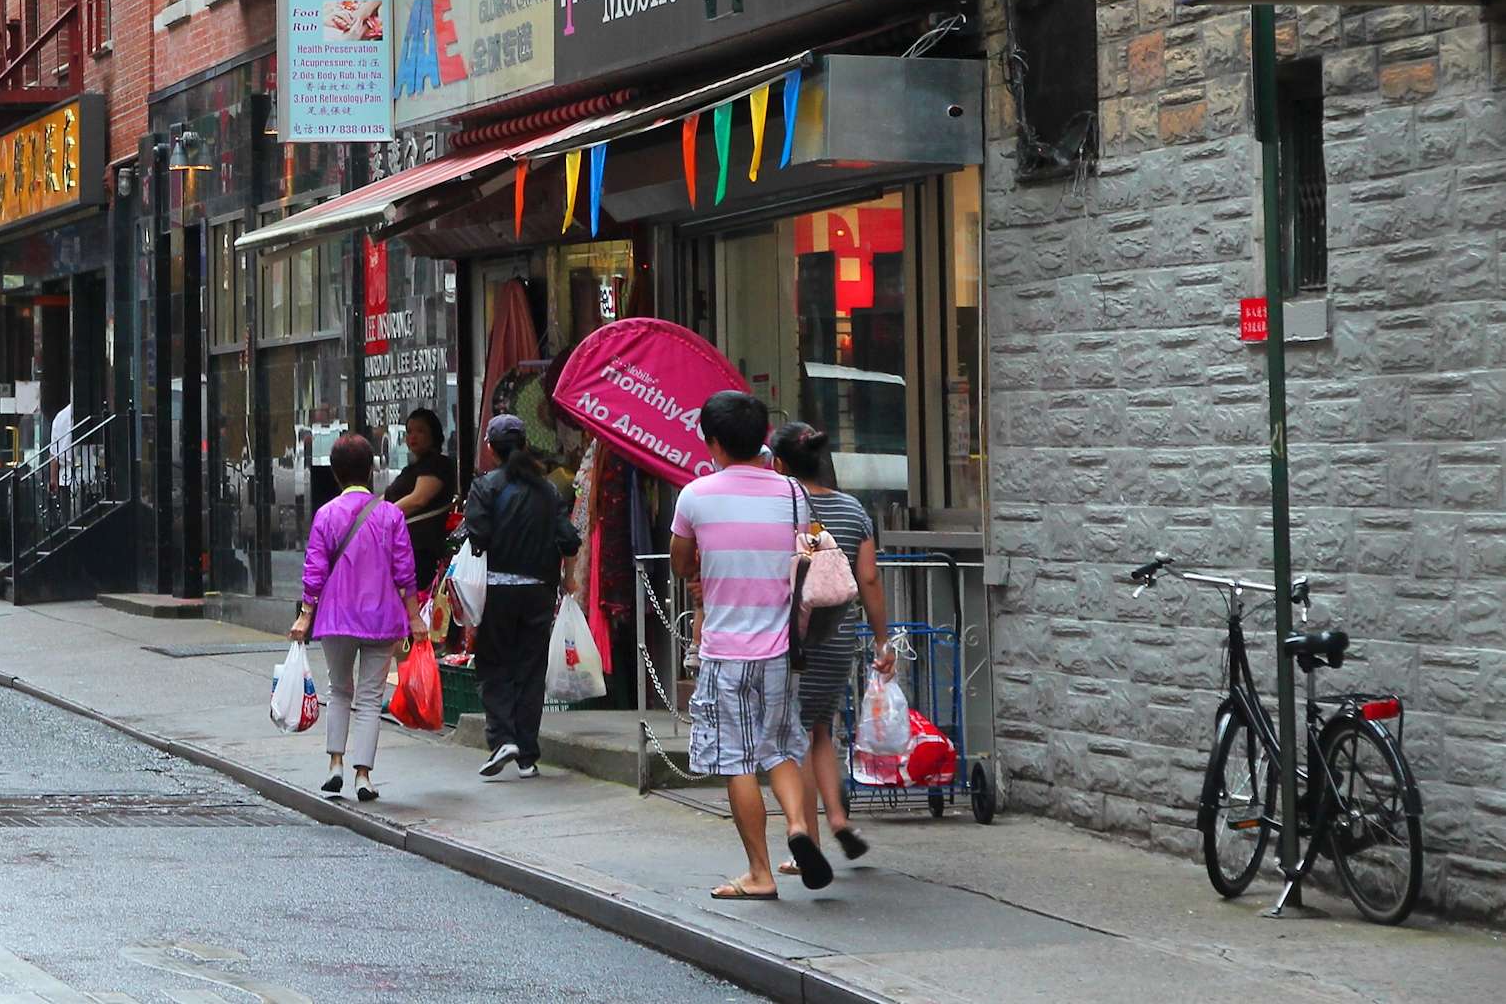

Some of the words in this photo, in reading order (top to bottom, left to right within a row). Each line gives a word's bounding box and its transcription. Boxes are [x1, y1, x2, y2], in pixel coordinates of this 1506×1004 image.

[293, 8, 319, 17] Foot
[293, 23, 317, 32] Rub
[297, 45, 323, 54] Health
[324, 45, 378, 54] Preservation
[317, 72, 336, 81] Body
[365, 315, 377, 342] LEE
[377, 309, 414, 341] INSURANCE
[364, 354, 390, 378] HAROLD
[397, 353, 410, 374] LEE
[418, 348, 437, 372] SONS
[365, 378, 401, 402] INSURANCE
[401, 375, 435, 400] SERVICES
[365, 404, 384, 427] SINCE
[577, 392, 610, 421] No
[612, 414, 692, 469] Annual
